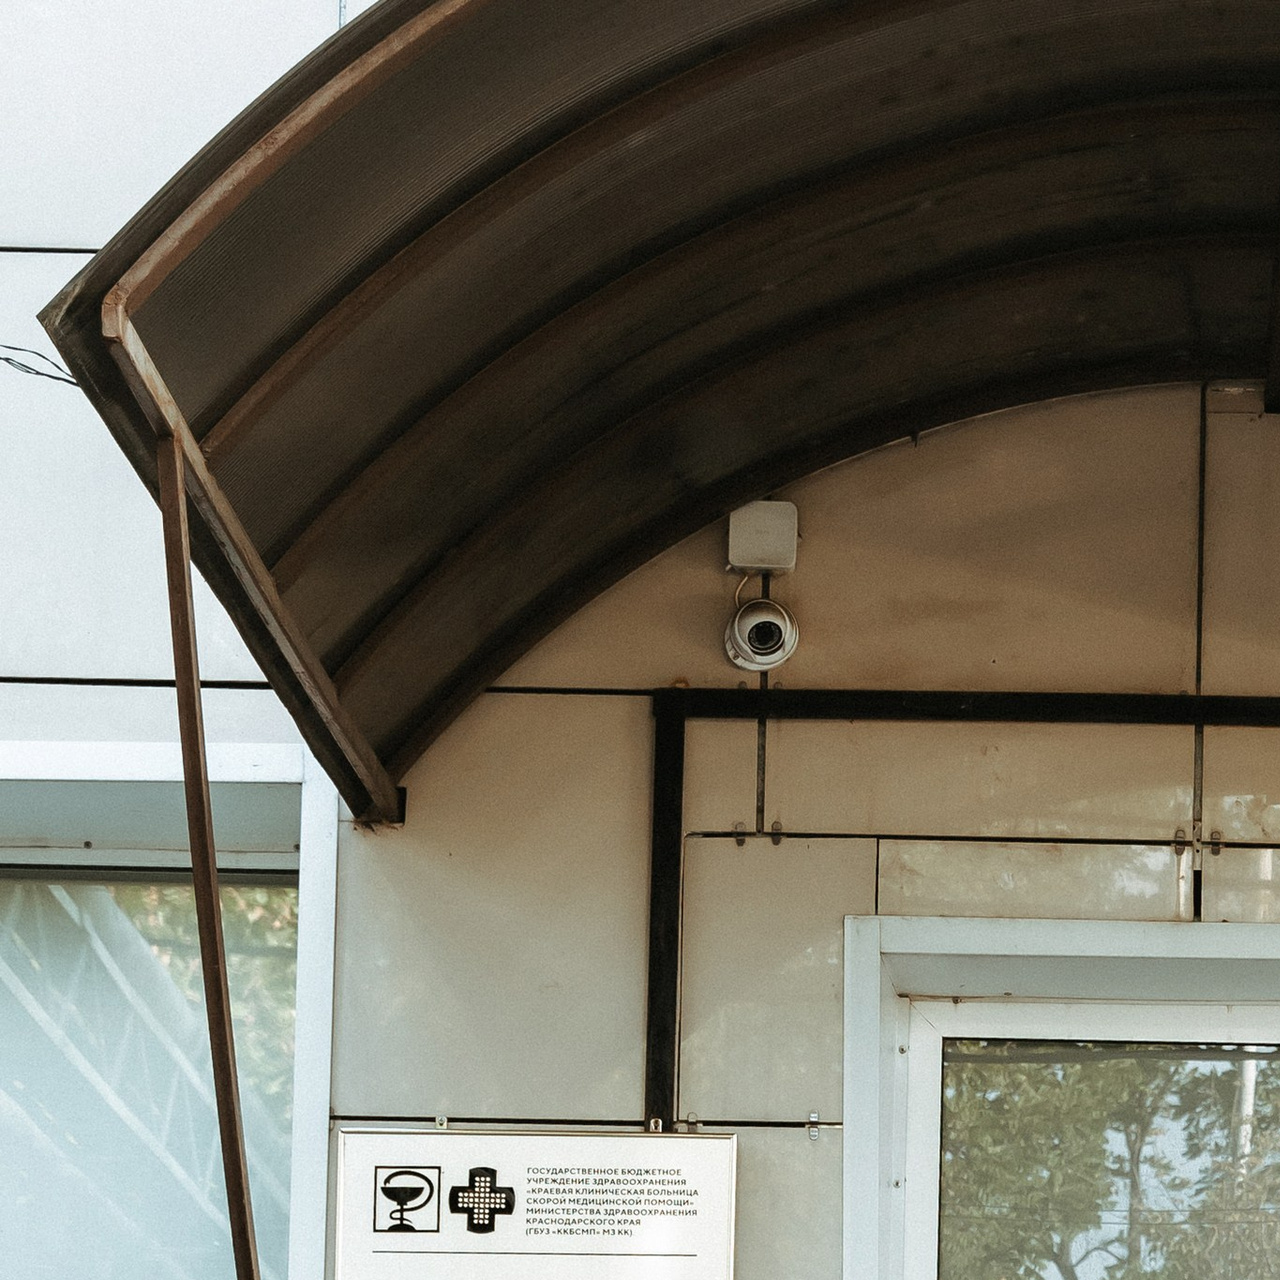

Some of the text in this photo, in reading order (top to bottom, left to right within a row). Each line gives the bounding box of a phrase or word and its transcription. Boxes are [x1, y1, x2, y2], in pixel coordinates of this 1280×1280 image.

[527, 1167, 682, 1177] ГОСУДАРСТВЕННОЕ БЮДЖЕТНОЕ
[526, 1177, 687, 1187] УЧРЕЖДЕНИЕ ЗДРАВООХРАНЕНИЯ
[575, 1188, 645, 1196] КЛИНИЧЕСКАЯ
[646, 1189, 699, 1197] БОЛЬНИЦА
[526, 1196, 567, 1205] СКОРОЙ
[568, 1197, 642, 1207] МЕДИЦИНСКОЙ
[603, 1209, 698, 1217] ЗДРАВООХРАНЕНИЯ
[525, 1218, 616, 1226] КРАСНОДАРСКОГО
[525, 1227, 551, 1236] (ГБУЗ
[602, 1228, 616, 1236] МЗ
[617, 1228, 633, 1237] КК)
